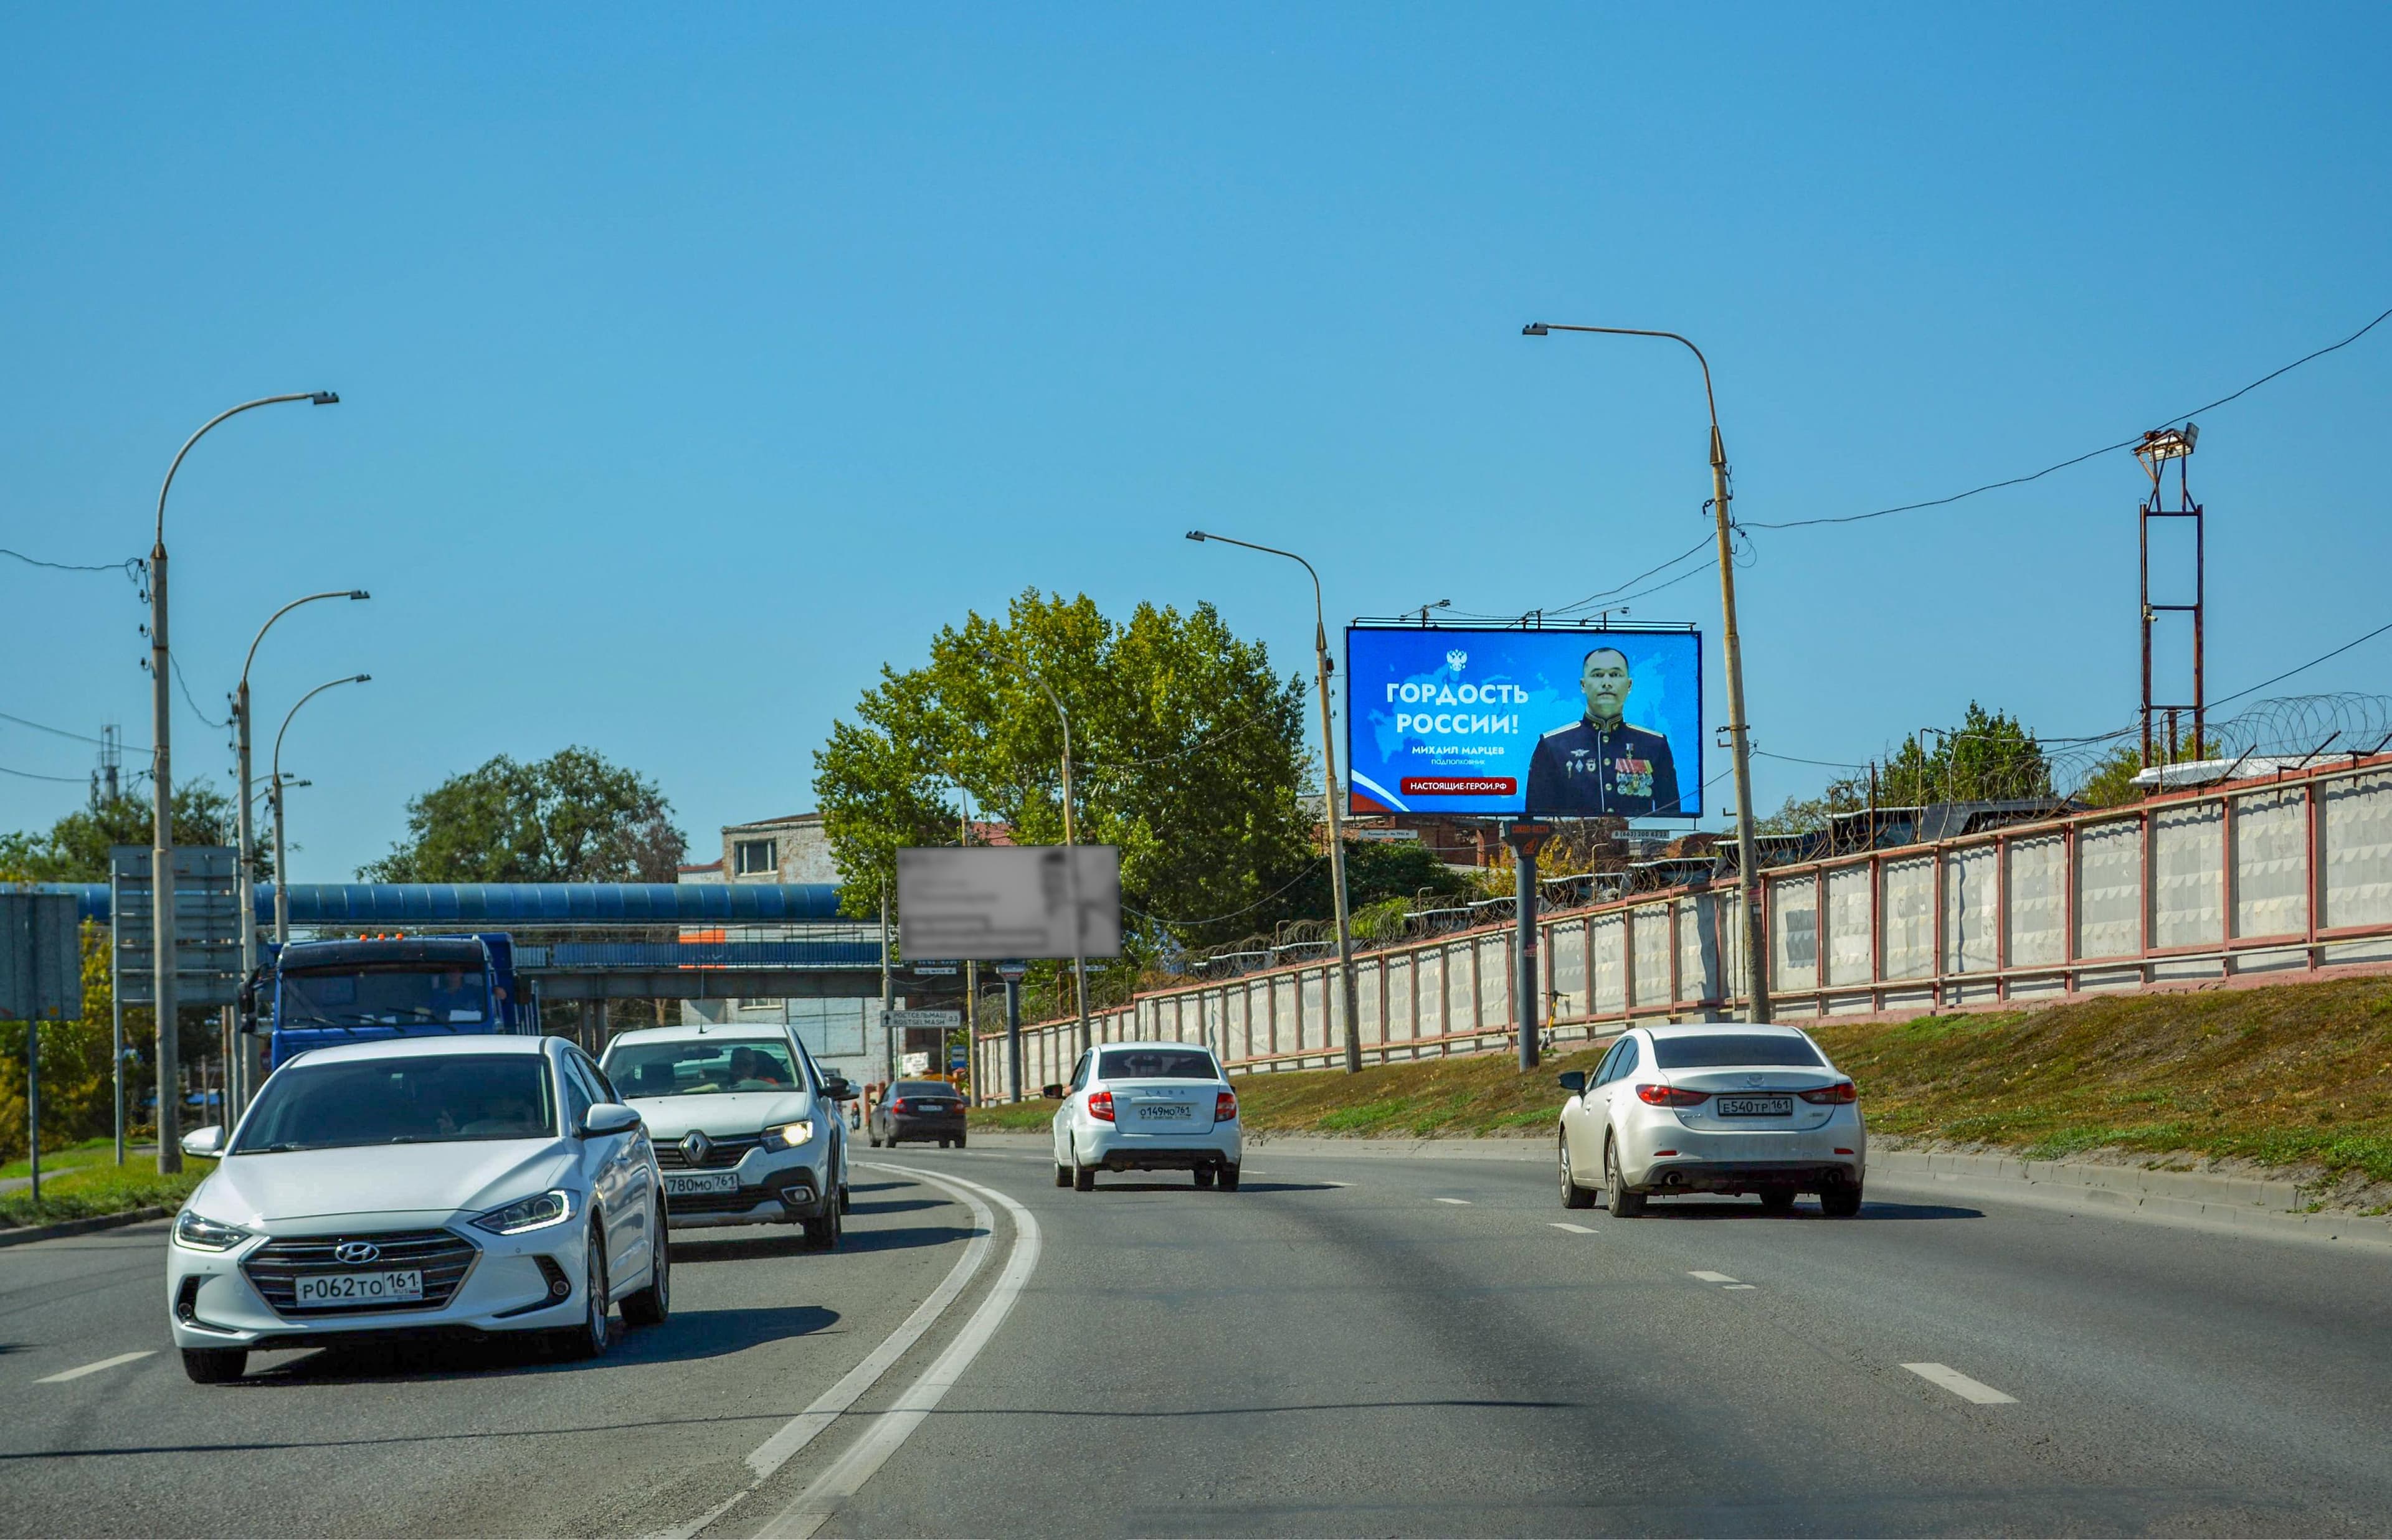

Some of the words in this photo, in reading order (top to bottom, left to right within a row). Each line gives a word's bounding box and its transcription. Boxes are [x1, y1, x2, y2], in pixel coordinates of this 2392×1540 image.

[1387, 683, 1529, 706] ГОРДОСТЬ
[1397, 713, 1519, 734] РОССИИ!
[1412, 746, 1458, 754] МИХАИЛ
[1461, 747, 1504, 755] МАРЦЕВ
[1410, 782, 1507, 790] НАСТОЯЩИЕ-ГЕРОИ.РФ
[1772, 1100, 1789, 1109] 161
[714, 1176, 734, 1186] 761
[386, 1272, 416, 1288] 161
